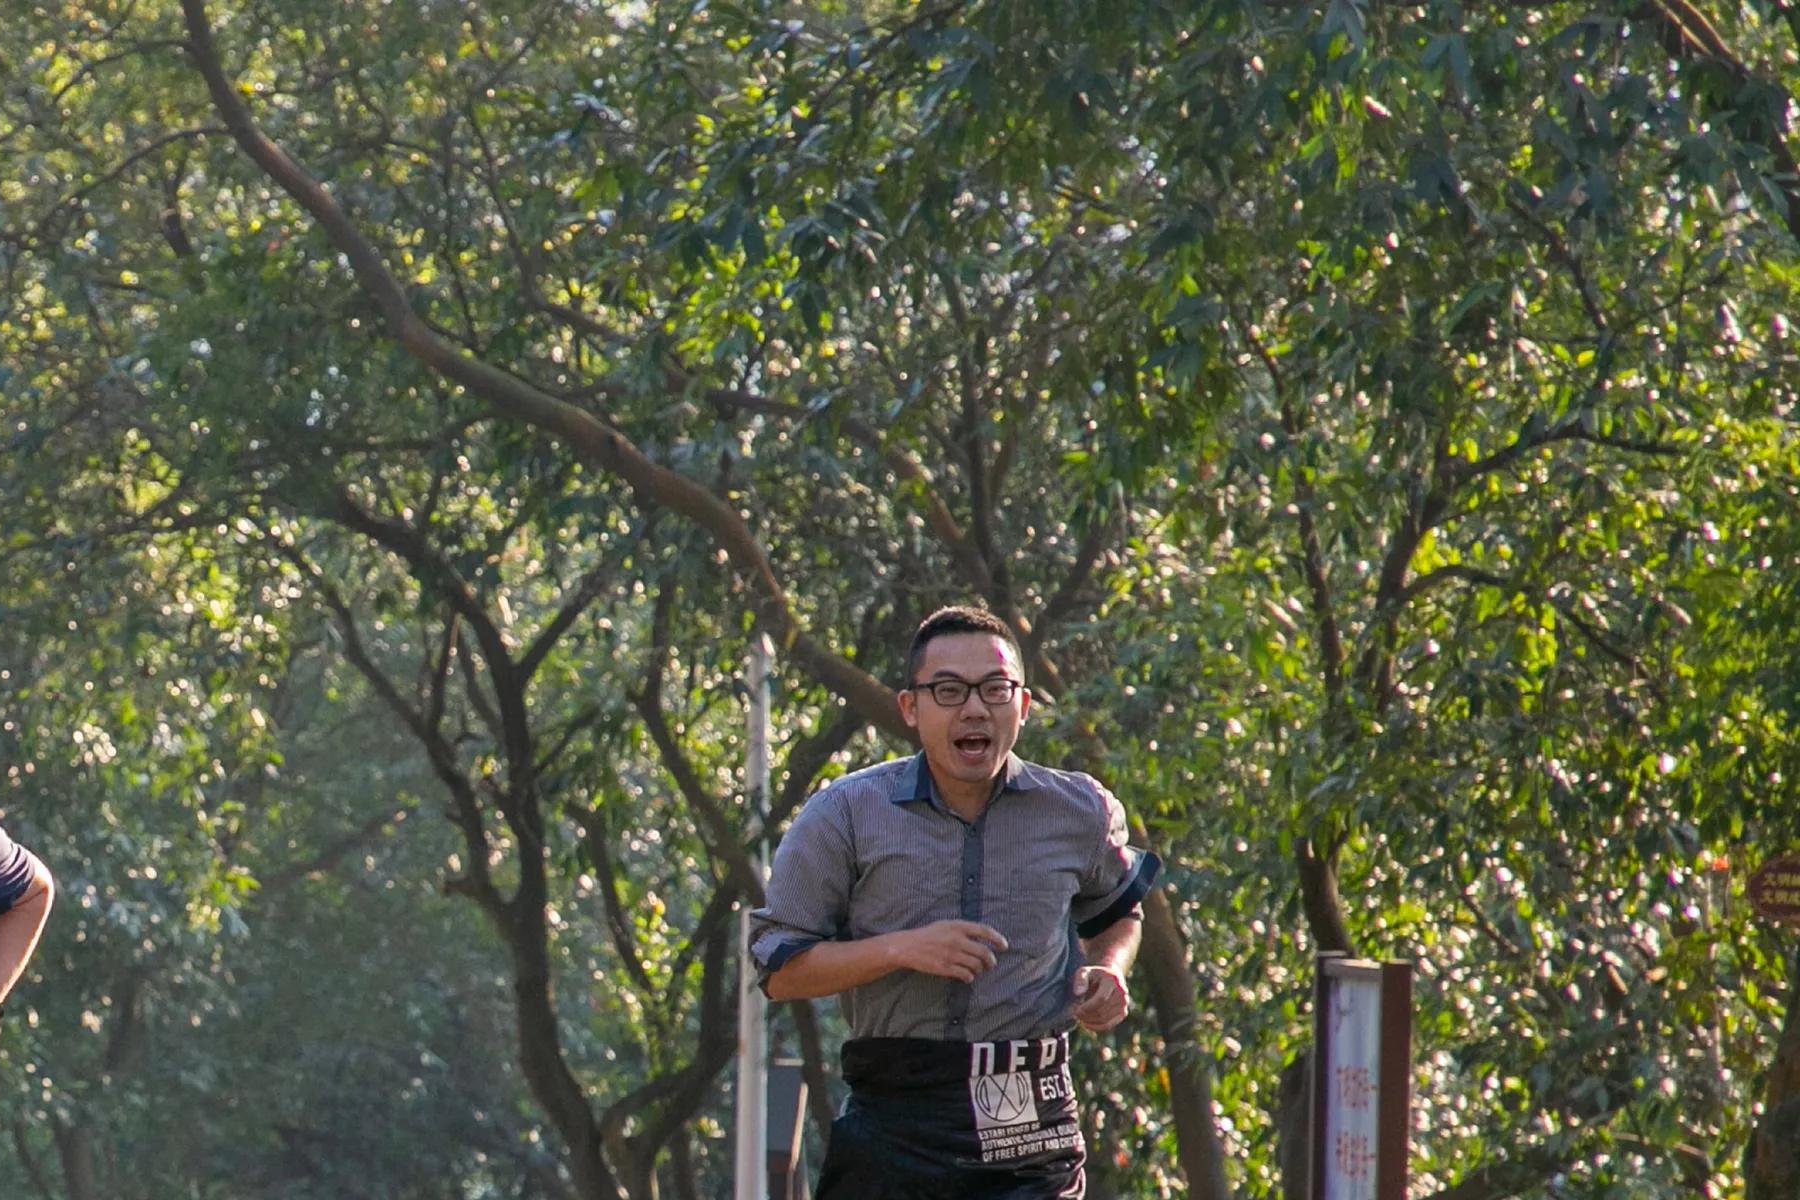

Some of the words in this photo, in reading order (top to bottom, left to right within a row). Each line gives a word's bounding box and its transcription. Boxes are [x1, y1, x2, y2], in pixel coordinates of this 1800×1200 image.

[982, 1151, 994, 1162] OF
[995, 1147, 1016, 1160] FREE
[1017, 1142, 1044, 1156] SPIRIT
